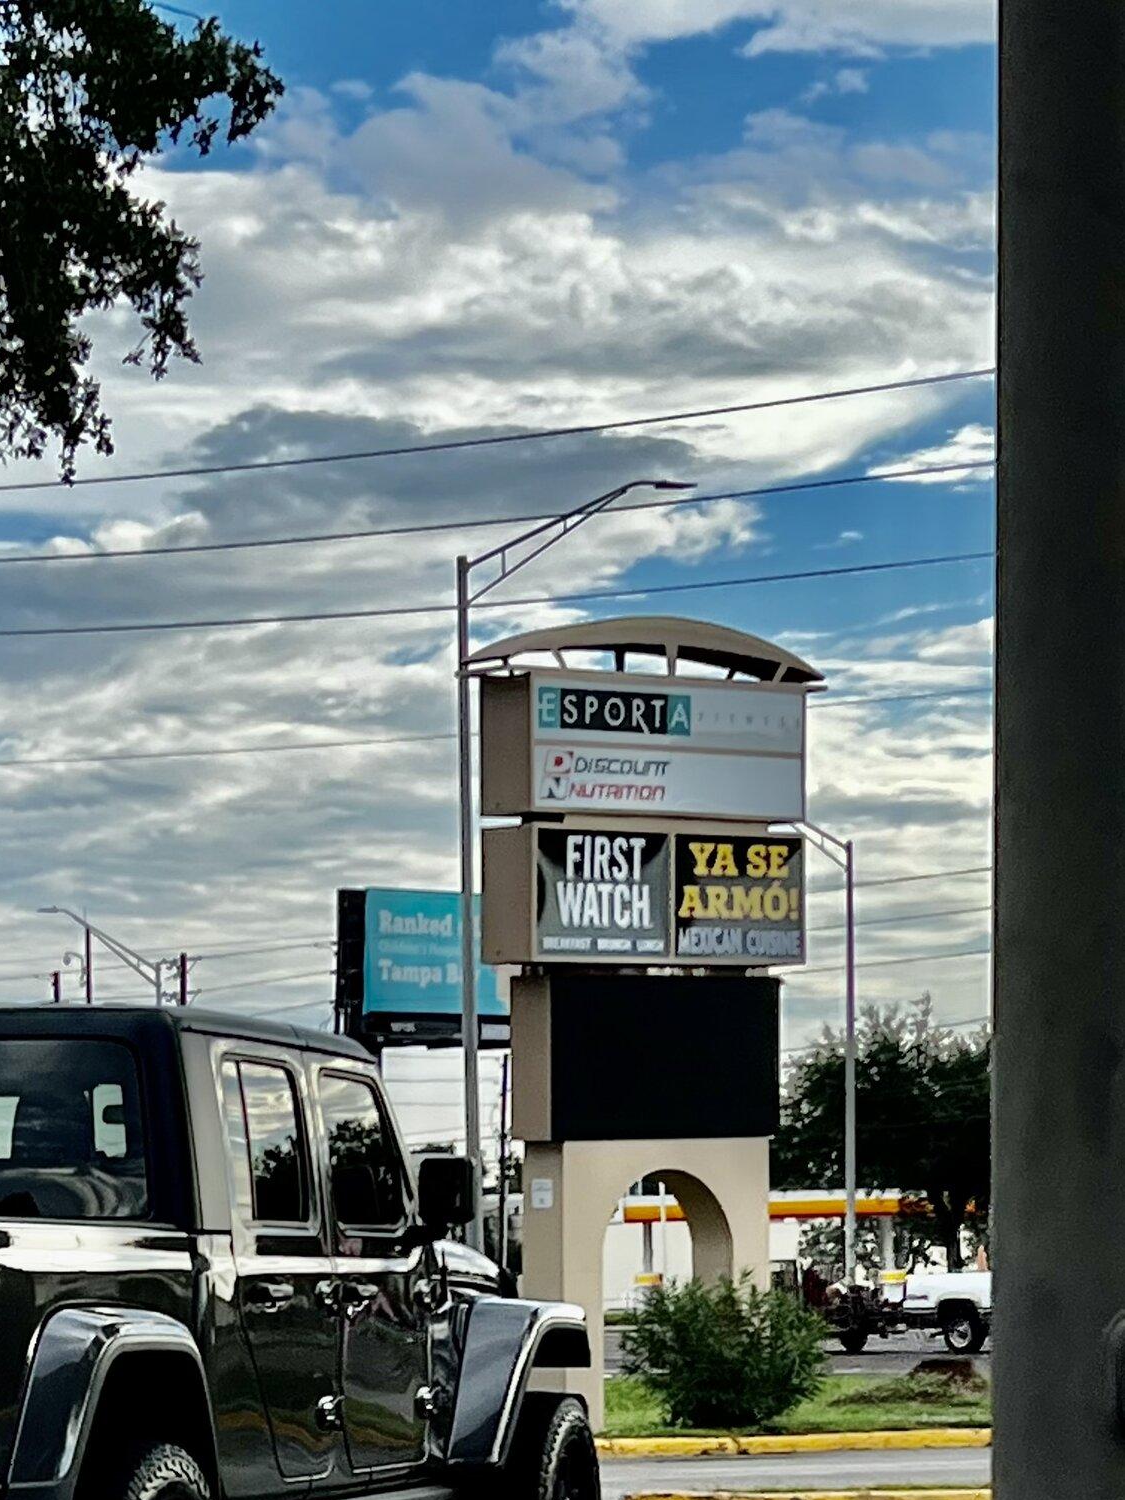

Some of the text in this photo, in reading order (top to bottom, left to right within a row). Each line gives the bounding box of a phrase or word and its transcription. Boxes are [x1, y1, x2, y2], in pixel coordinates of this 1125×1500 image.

[539, 692, 690, 735] ESPORTA
[574, 757, 669, 776] DISCOUNT
[569, 782, 665, 800] NUTRITION
[566, 834, 647, 881] FIRST
[688, 842, 789, 879] YA SE
[556, 880, 652, 929] WATCH
[678, 879, 800, 921] ARMÓ!
[378, 909, 453, 937] Ranked
[378, 958, 442, 988] Tampa
